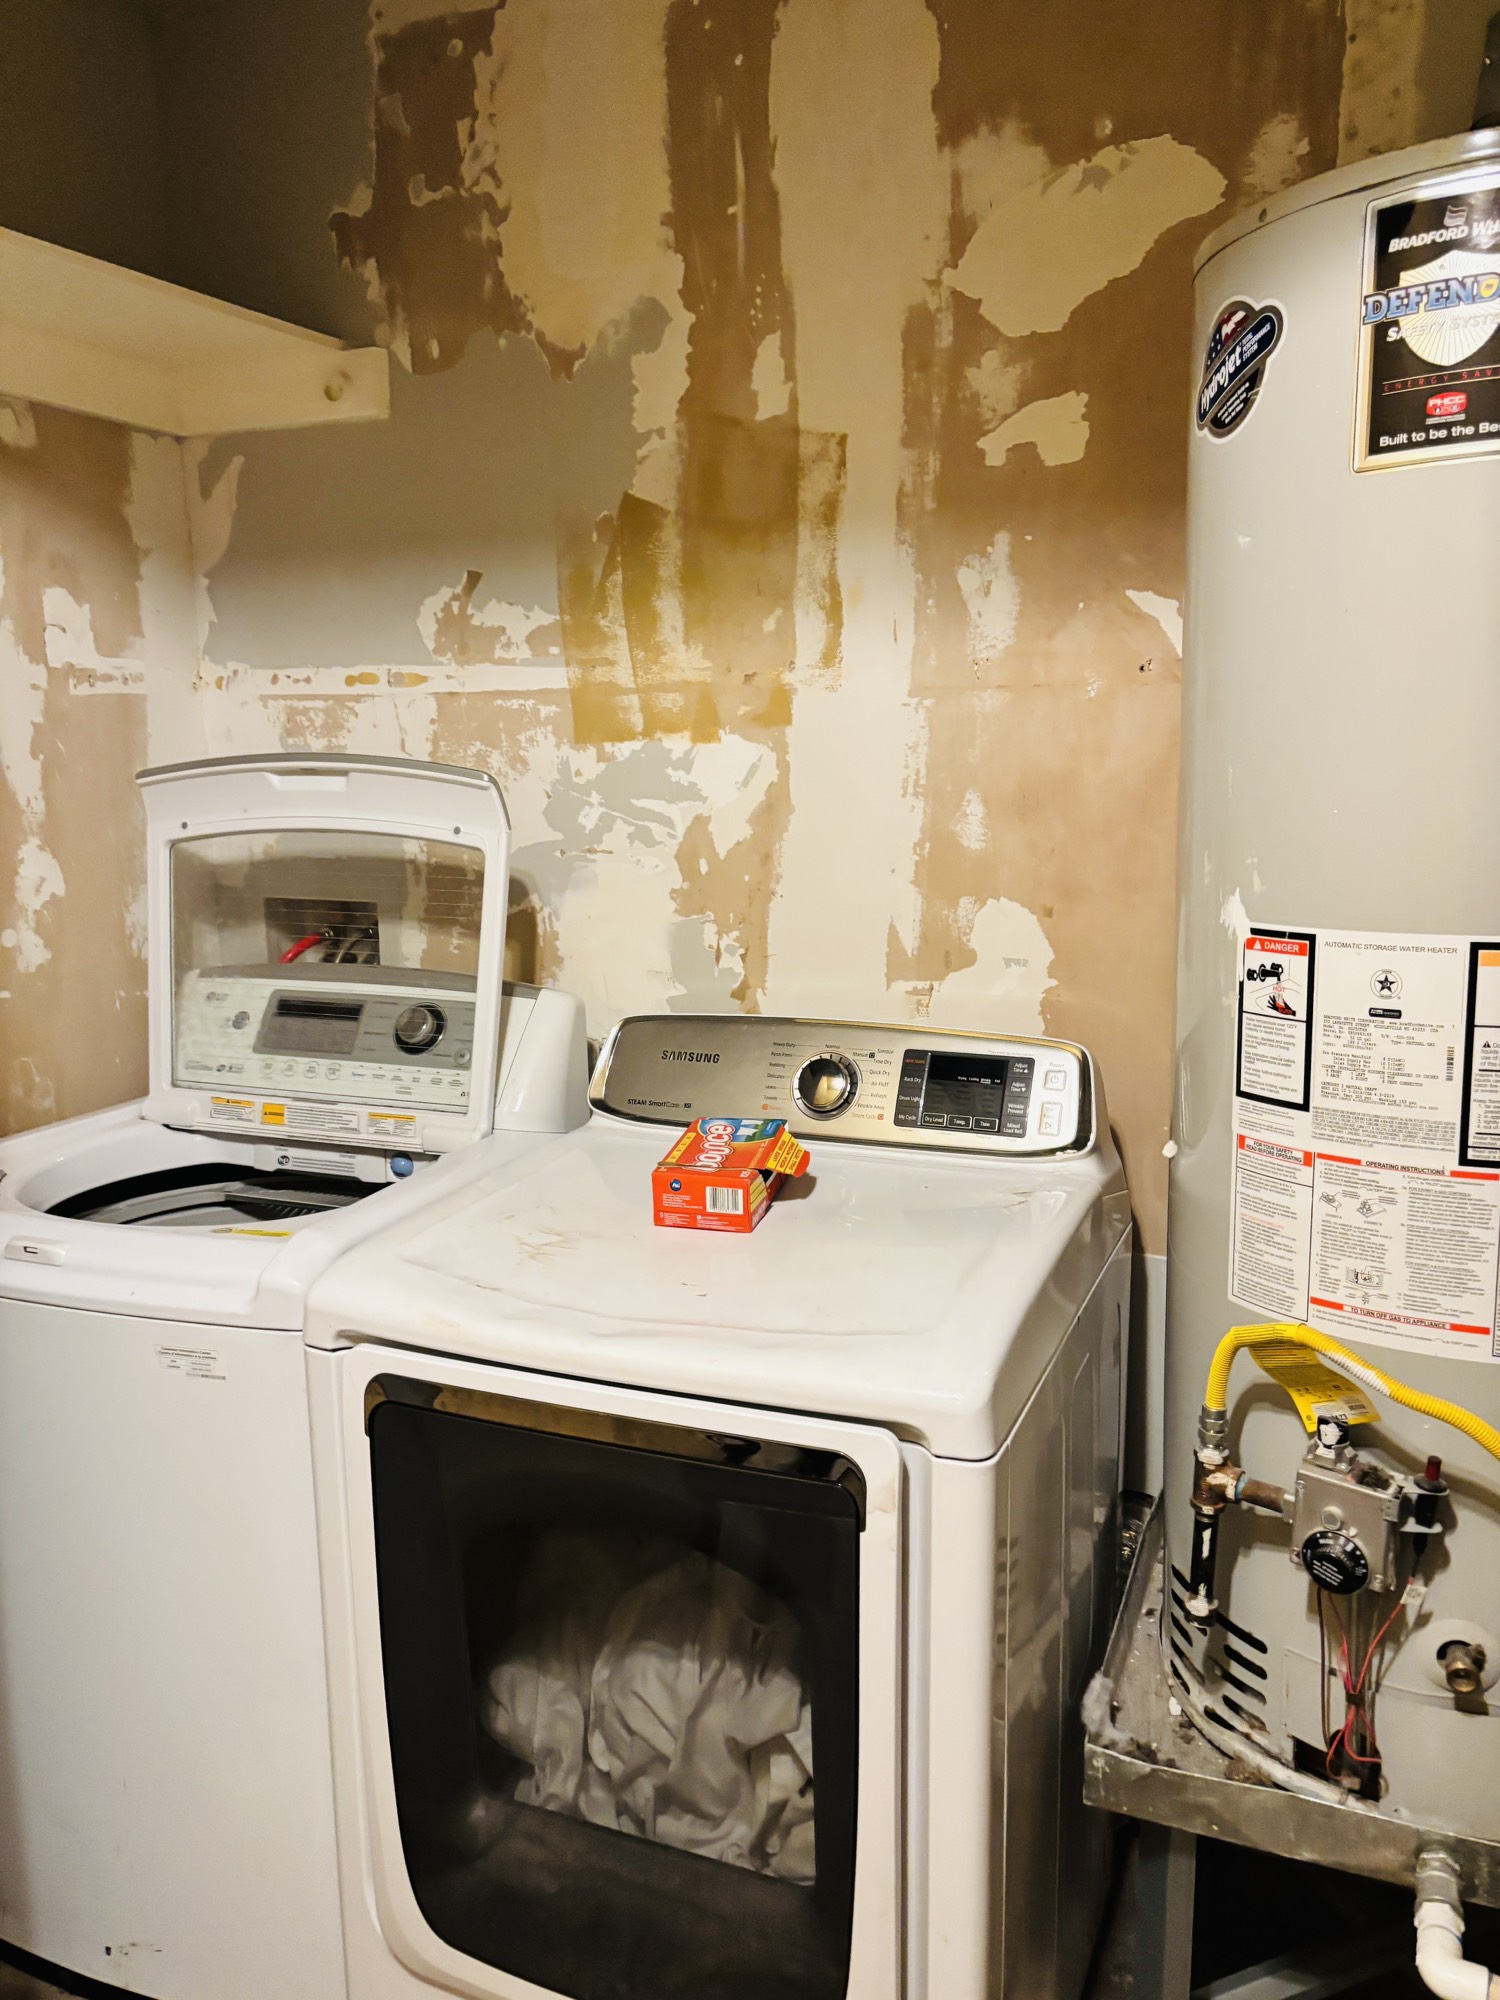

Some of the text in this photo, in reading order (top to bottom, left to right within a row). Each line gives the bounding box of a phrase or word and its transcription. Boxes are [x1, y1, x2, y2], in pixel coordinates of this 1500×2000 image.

[1388, 226, 1468, 253] BRADFORD
[1242, 342, 1258, 362] SYSTEM
[1200, 344, 1242, 414] Hydrojet
[1384, 370, 1500, 392] ENERGY SAV
[1429, 394, 1466, 407] PHCC
[1380, 422, 1500, 447] Built to be the Be
[1264, 942, 1300, 952] DANGER
[1324, 941, 1362, 950] AUTOMATIC
[1364, 944, 1397, 952] STORAGE
[661, 1050, 720, 1064] SAMSUNG
[1246, 1144, 1302, 1163] READ BEFORE OPERATING
[1276, 1146, 1293, 1155] SAFETY
[1366, 1160, 1445, 1176] OPERATING INSTRUCTIONS
[1360, 1309, 1375, 1317] TURN
[1388, 1314, 1401, 1322] GAS
[1412, 1318, 1446, 1329] APPLIANCE
